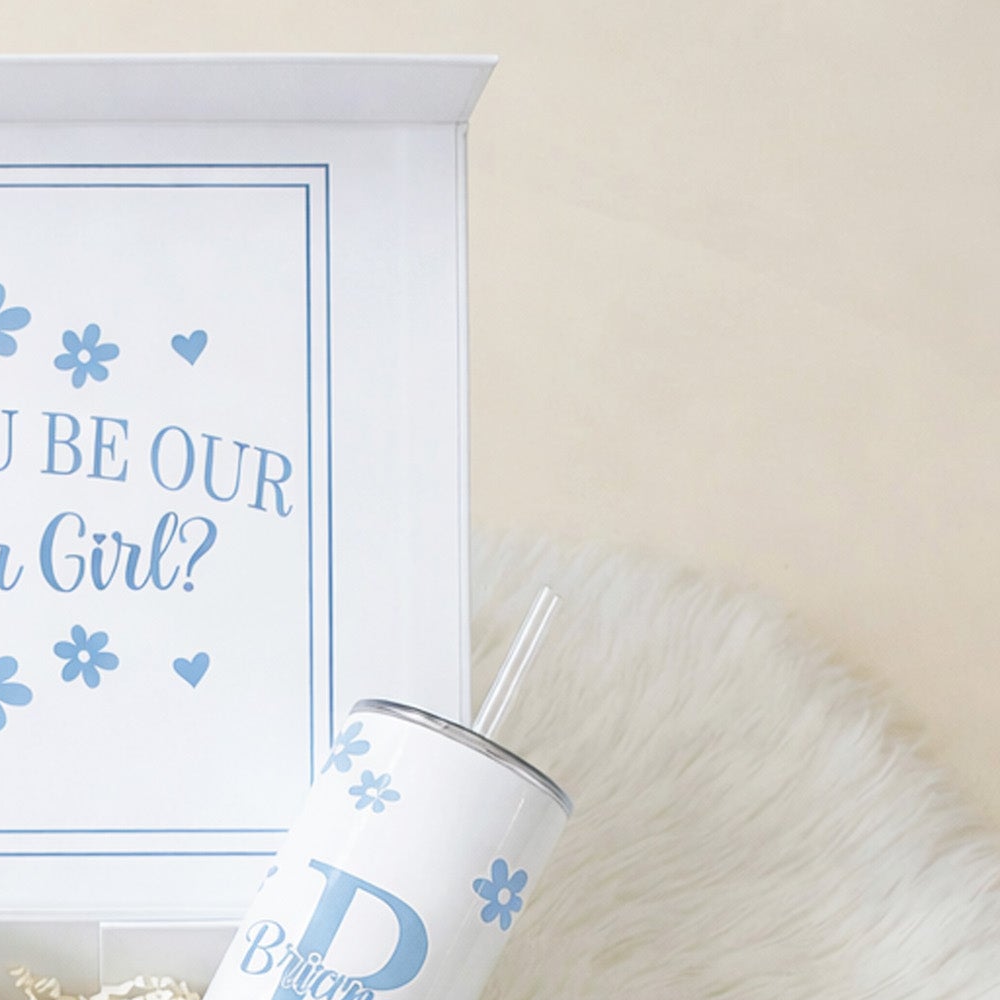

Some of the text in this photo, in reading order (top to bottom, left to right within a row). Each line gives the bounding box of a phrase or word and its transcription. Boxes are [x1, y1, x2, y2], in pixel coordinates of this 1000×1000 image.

[41, 411, 129, 482] BE
[150, 425, 293, 518] OUR
[39, 511, 218, 593] Girl?
